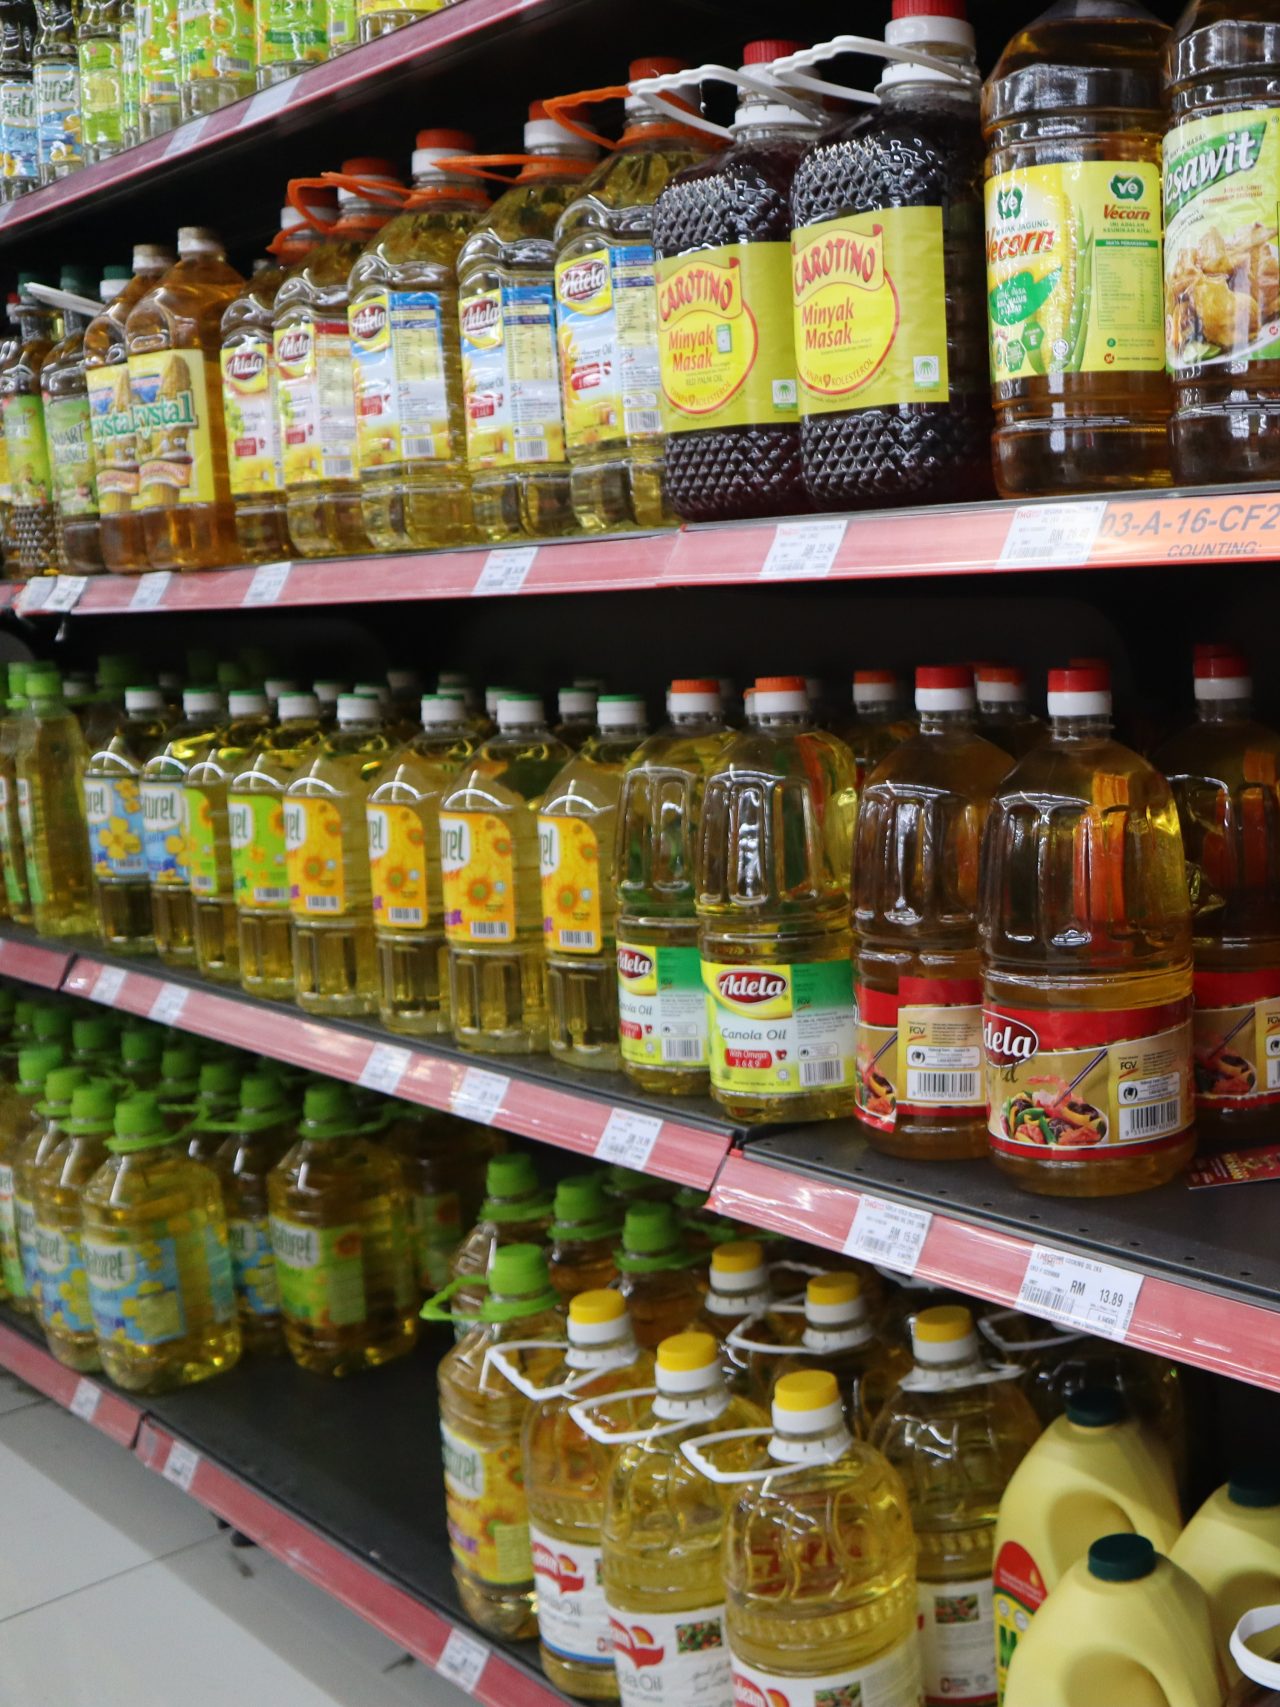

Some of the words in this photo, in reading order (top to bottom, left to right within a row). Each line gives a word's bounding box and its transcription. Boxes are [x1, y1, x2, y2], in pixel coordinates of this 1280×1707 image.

[1165, 131, 1256, 205] esawit
[1103, 204, 1151, 221] Vecorn
[794, 238, 876, 297] CAROTINO
[560, 264, 608, 296] Adela
[660, 269, 733, 322] CAROTINO
[802, 297, 854, 328] Minyak
[668, 324, 714, 352] Minyak
[805, 322, 853, 351] Masak
[672, 349, 713, 373] Masak
[1167, 541, 1262, 558] COUNTING:
[719, 974, 788, 998] Adela
[638, 1004, 653, 1016] Oil
[721, 1027, 762, 1041] Canola
[766, 1028, 787, 1041] Oil
[909, 1026, 925, 1035] FGV
[983, 1021, 1035, 1058] dela
[729, 1049, 744, 1059] With
[744, 1050, 768, 1062] Omega
[1119, 1061, 1137, 1071] FGV
[1069, 1279, 1086, 1296] RM
[1099, 1288, 1124, 1308] 13.89
[639, 1675, 663, 1692] Oil
